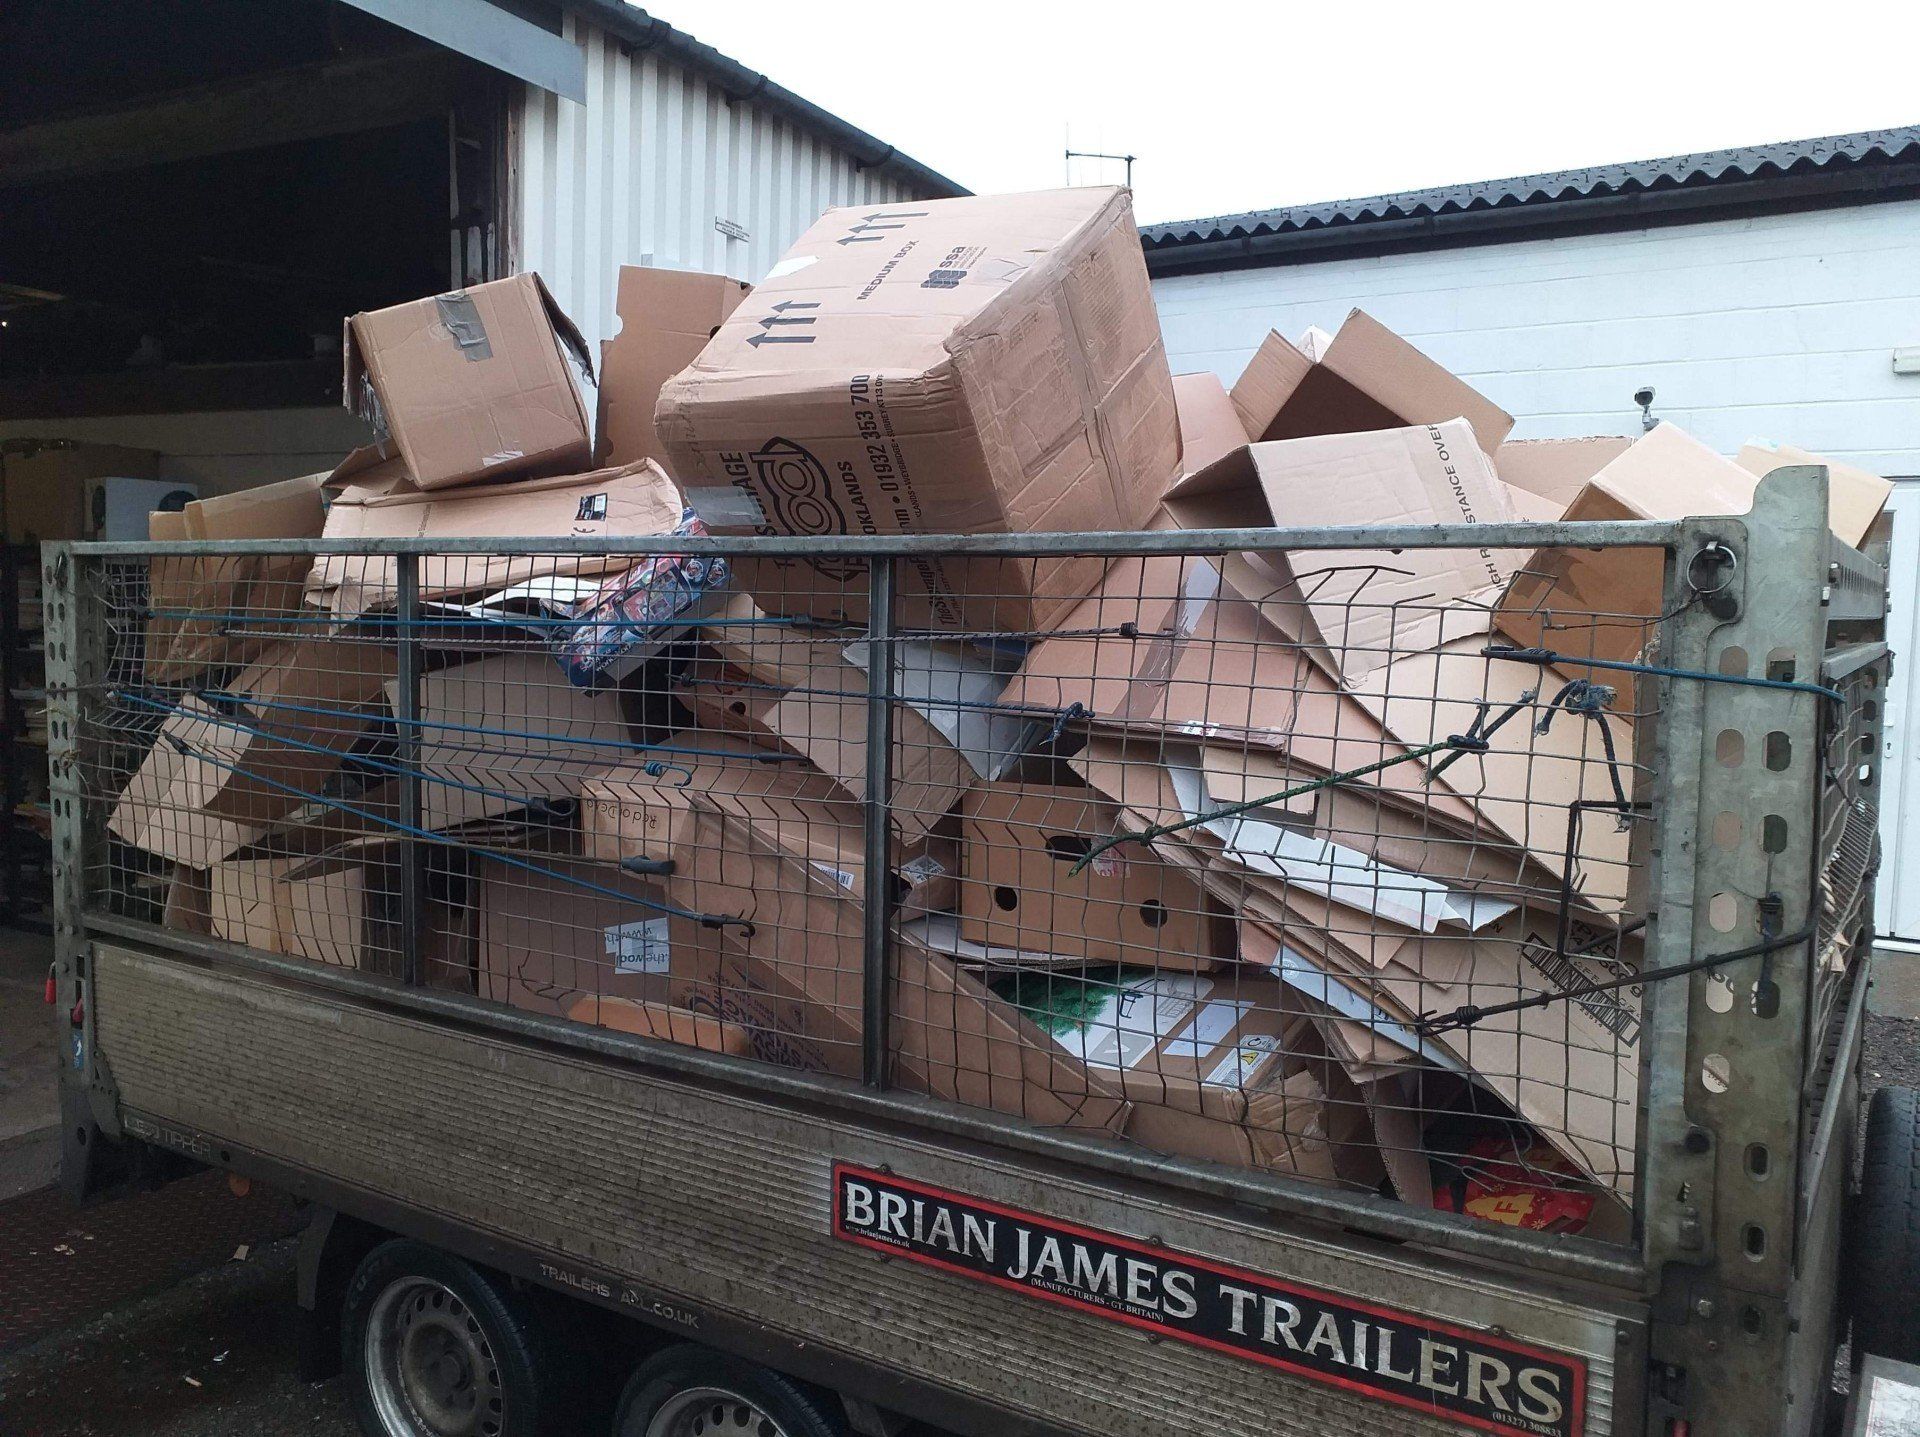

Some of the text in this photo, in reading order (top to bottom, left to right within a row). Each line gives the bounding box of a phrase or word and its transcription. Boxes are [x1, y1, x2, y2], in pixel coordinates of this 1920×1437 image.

[857, 240, 920, 300] MEDIUM BOX
[939, 246, 966, 268] ssa
[850, 374, 871, 406] 700
[855, 410, 881, 439] 353
[880, 409, 896, 437] SURREY
[866, 444, 899, 491] 01932
[891, 443, 912, 486] WEYBRIDGE
[586, 799, 617, 819] Ded
[540, 1262, 611, 1298] TRAILERS
[845, 1182, 1563, 1423] BRIAN JAMES TRAILERS
[1030, 1277, 1105, 1306] (MANUFACTURERS
[1125, 1304, 1164, 1323] BRITAIN)
[1492, 1411, 1527, 1431] (01327)
